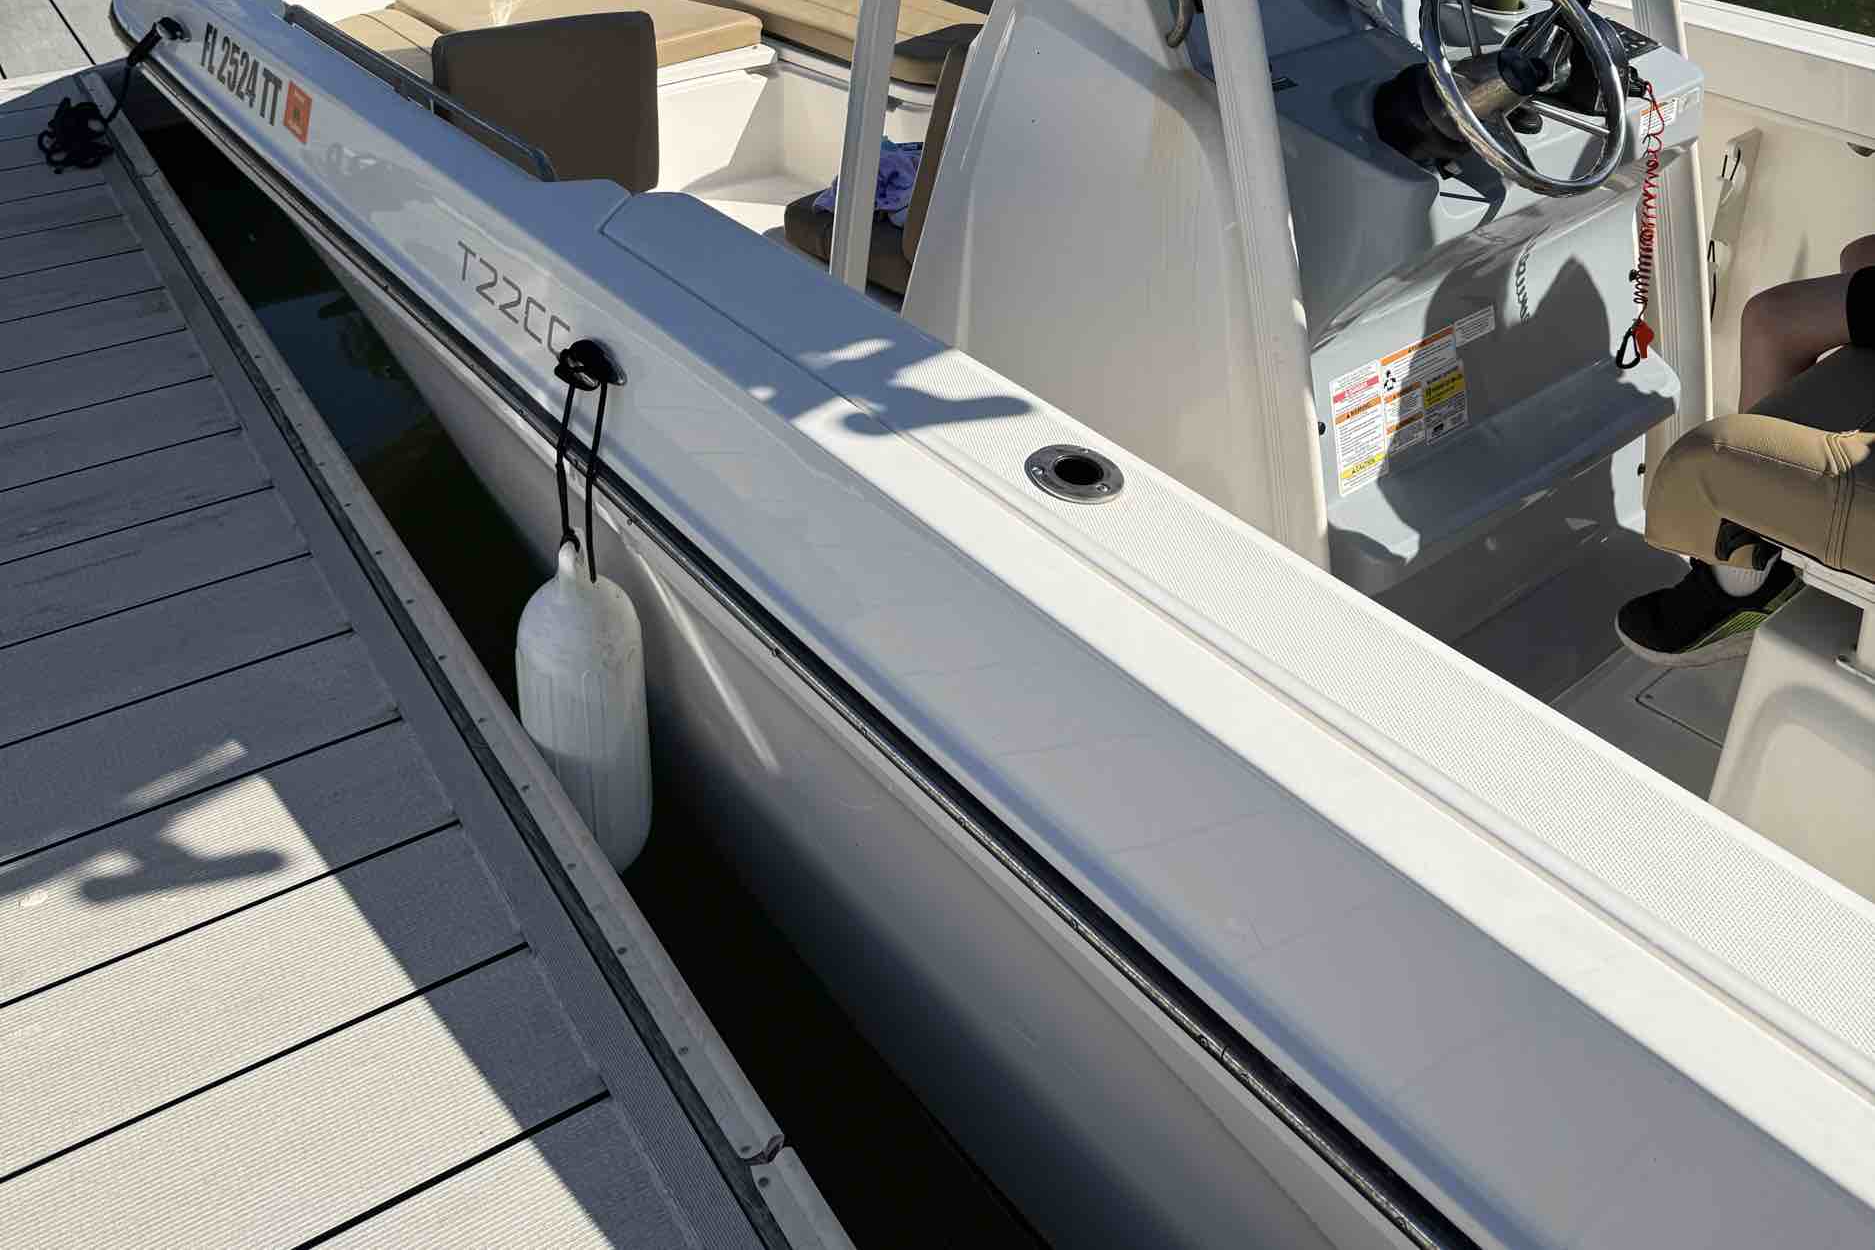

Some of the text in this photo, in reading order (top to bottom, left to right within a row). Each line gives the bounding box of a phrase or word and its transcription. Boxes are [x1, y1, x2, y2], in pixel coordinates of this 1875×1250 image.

[201, 22, 218, 75] FL
[217, 35, 259, 108] 2524
[260, 67, 282, 126] TT
[457, 240, 571, 361] T22CC
